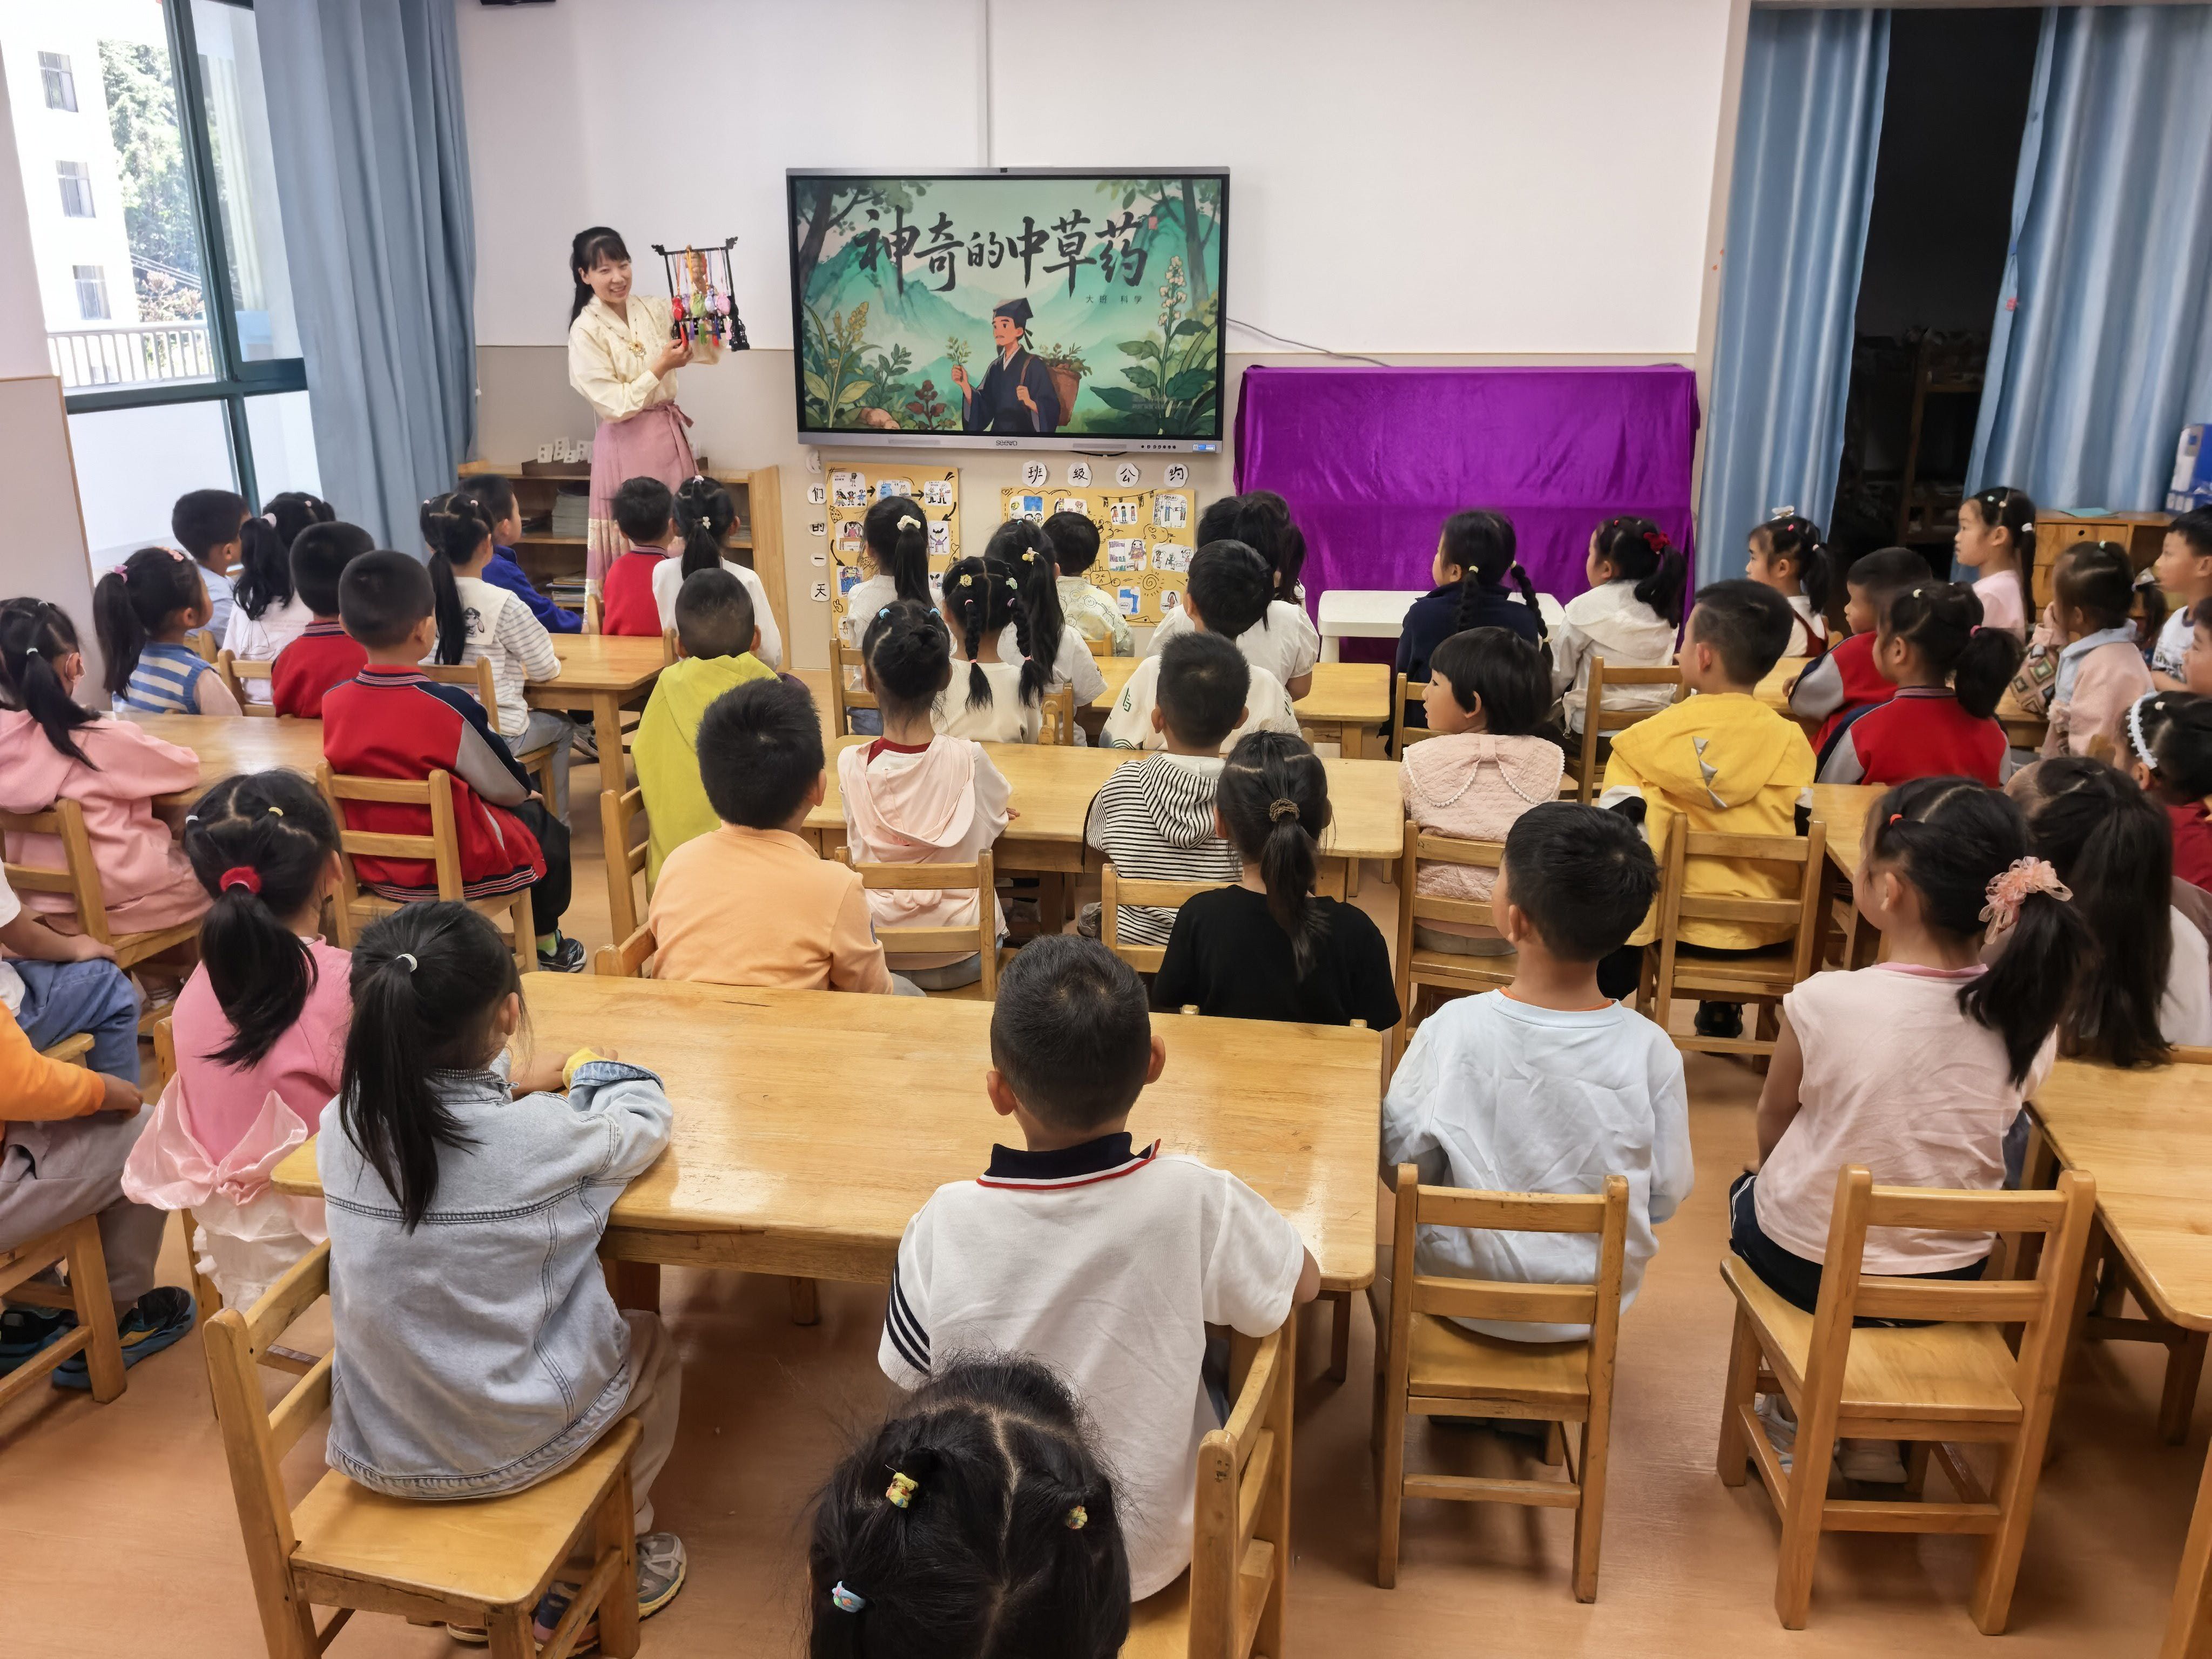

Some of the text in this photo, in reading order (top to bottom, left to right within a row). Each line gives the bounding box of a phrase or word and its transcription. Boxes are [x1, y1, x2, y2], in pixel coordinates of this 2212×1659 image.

[855, 205, 1148, 298] 神奇的中草药
[1028, 466, 1183, 483] 班级公约
